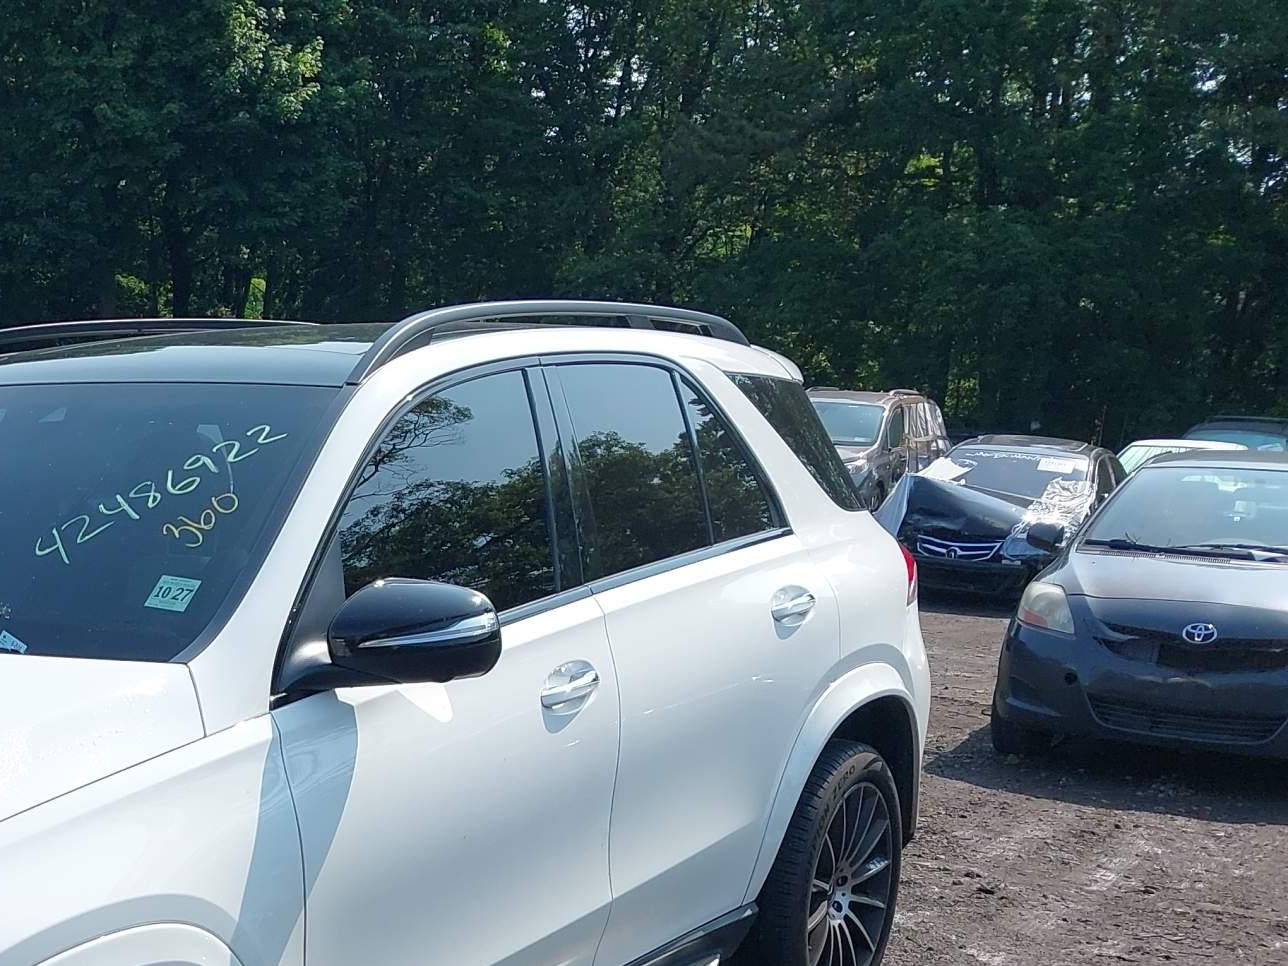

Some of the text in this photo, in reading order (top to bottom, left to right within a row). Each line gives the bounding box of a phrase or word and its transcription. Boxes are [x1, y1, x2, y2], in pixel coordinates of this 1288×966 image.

[34, 424, 289, 565] 42486922
[162, 492, 239, 547] 360
[153, 586, 194, 602] 10 27
